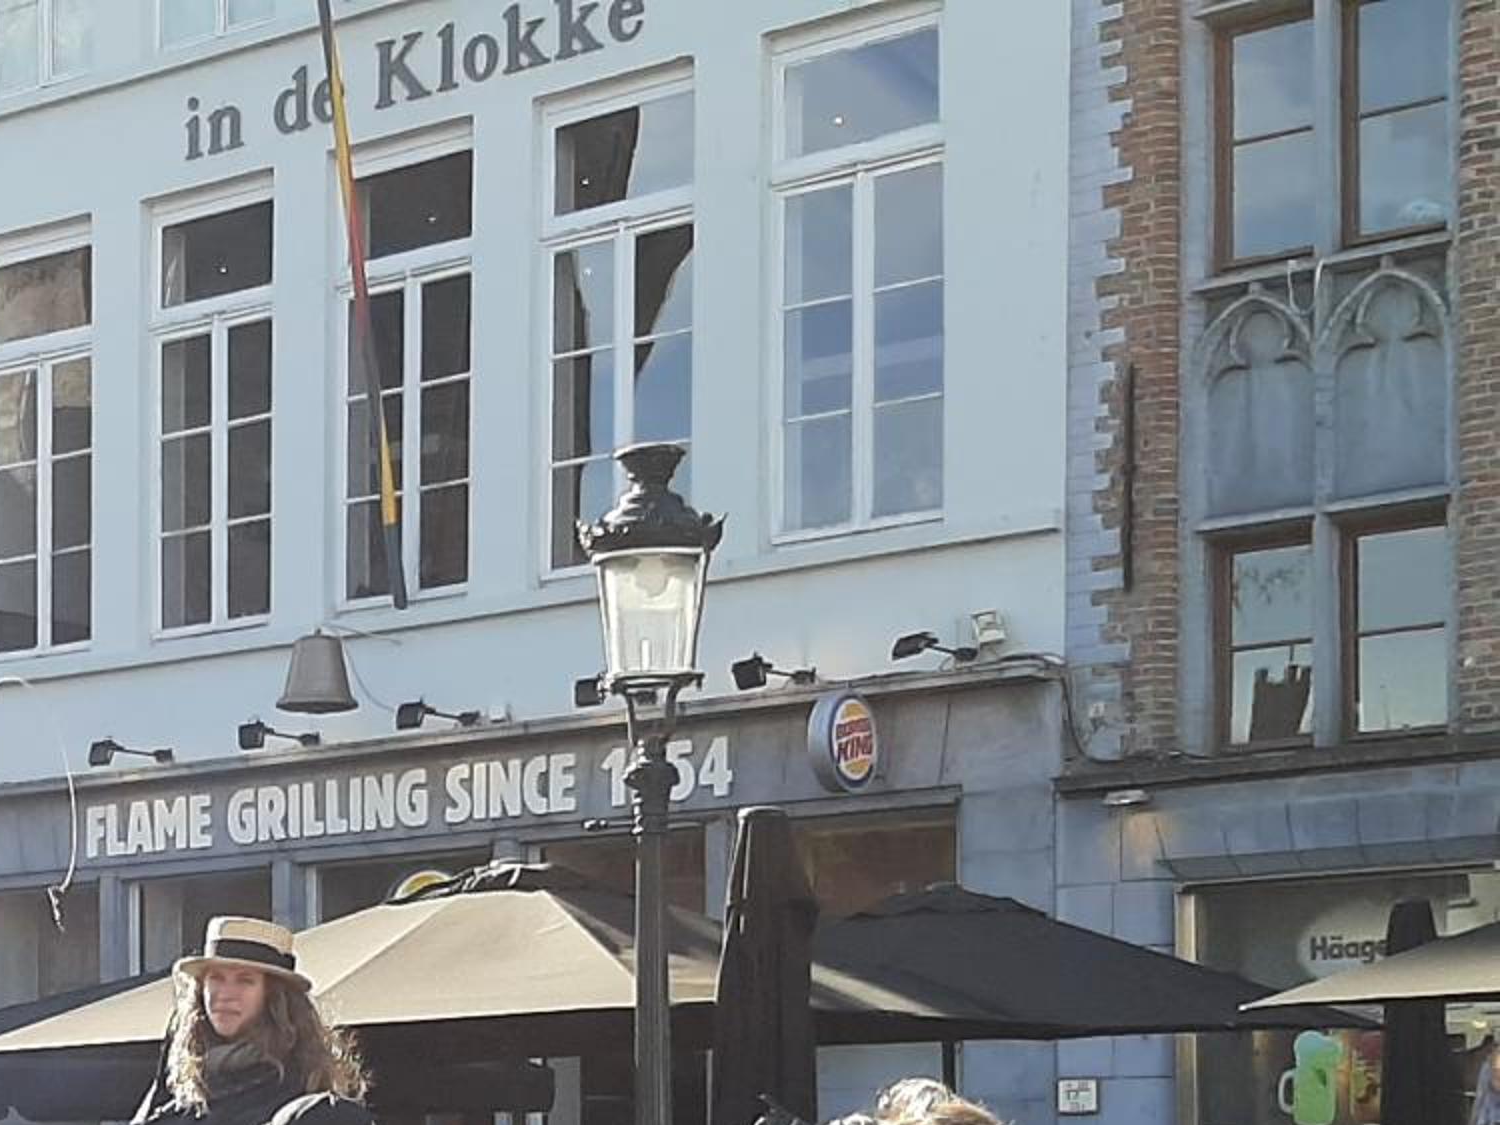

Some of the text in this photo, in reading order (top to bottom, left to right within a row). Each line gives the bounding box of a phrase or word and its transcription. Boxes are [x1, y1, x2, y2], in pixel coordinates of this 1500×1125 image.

[185, 0, 645, 160] in de Klokke
[86, 736, 733, 858] FLAME GRILLING SINCE 154
[837, 734, 873, 763] KING
